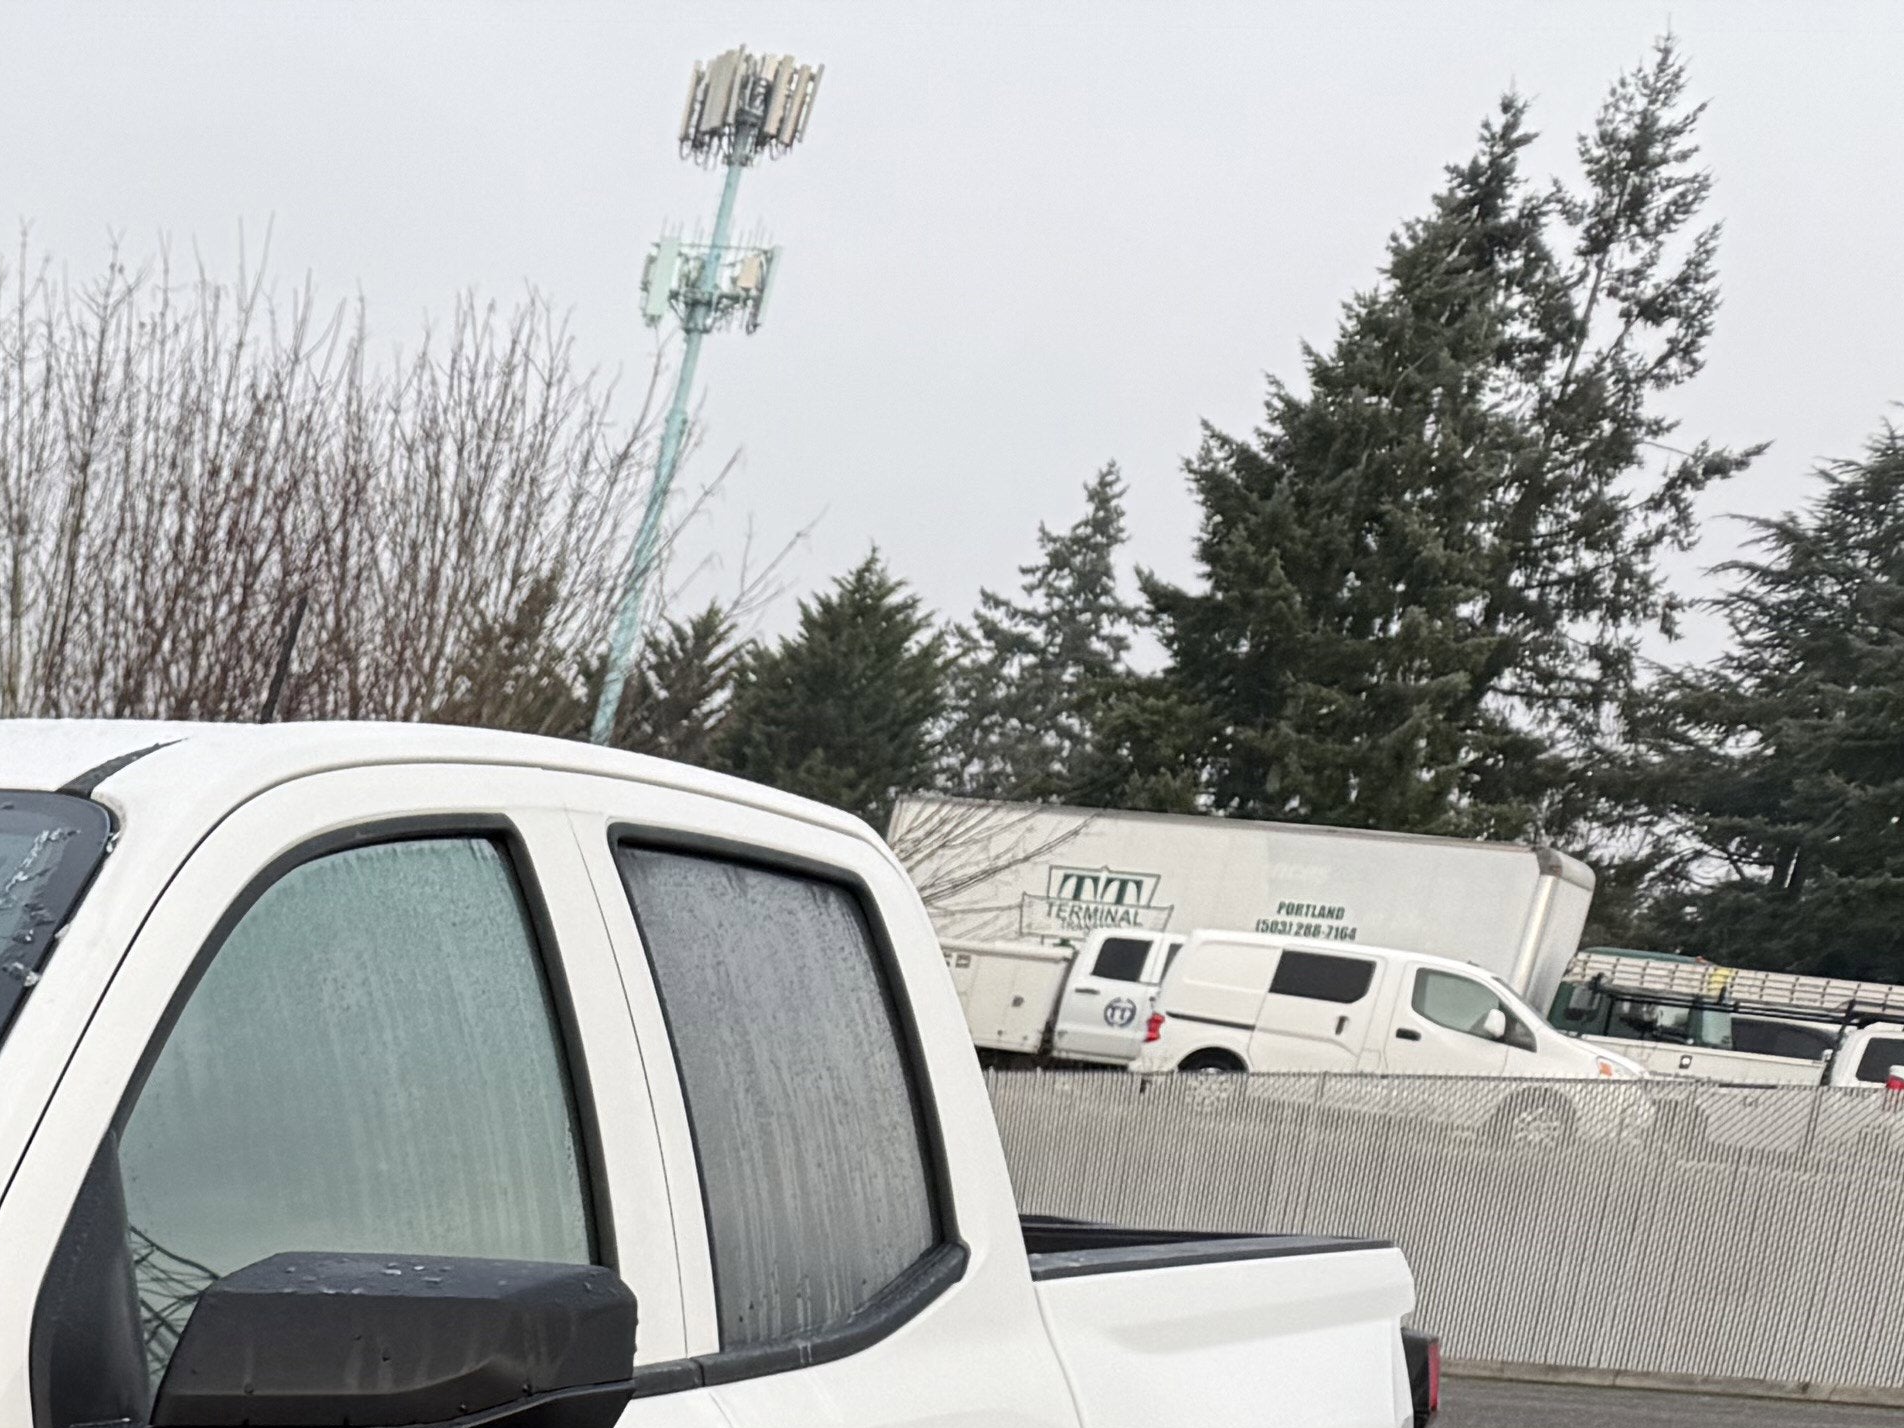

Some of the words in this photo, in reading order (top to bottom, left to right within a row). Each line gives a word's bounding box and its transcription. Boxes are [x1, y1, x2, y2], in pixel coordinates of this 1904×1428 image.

[1046, 901, 1144, 928] TERMINAL
[1276, 901, 1346, 920] PORTLAND
[1255, 918, 1293, 936] (503)
